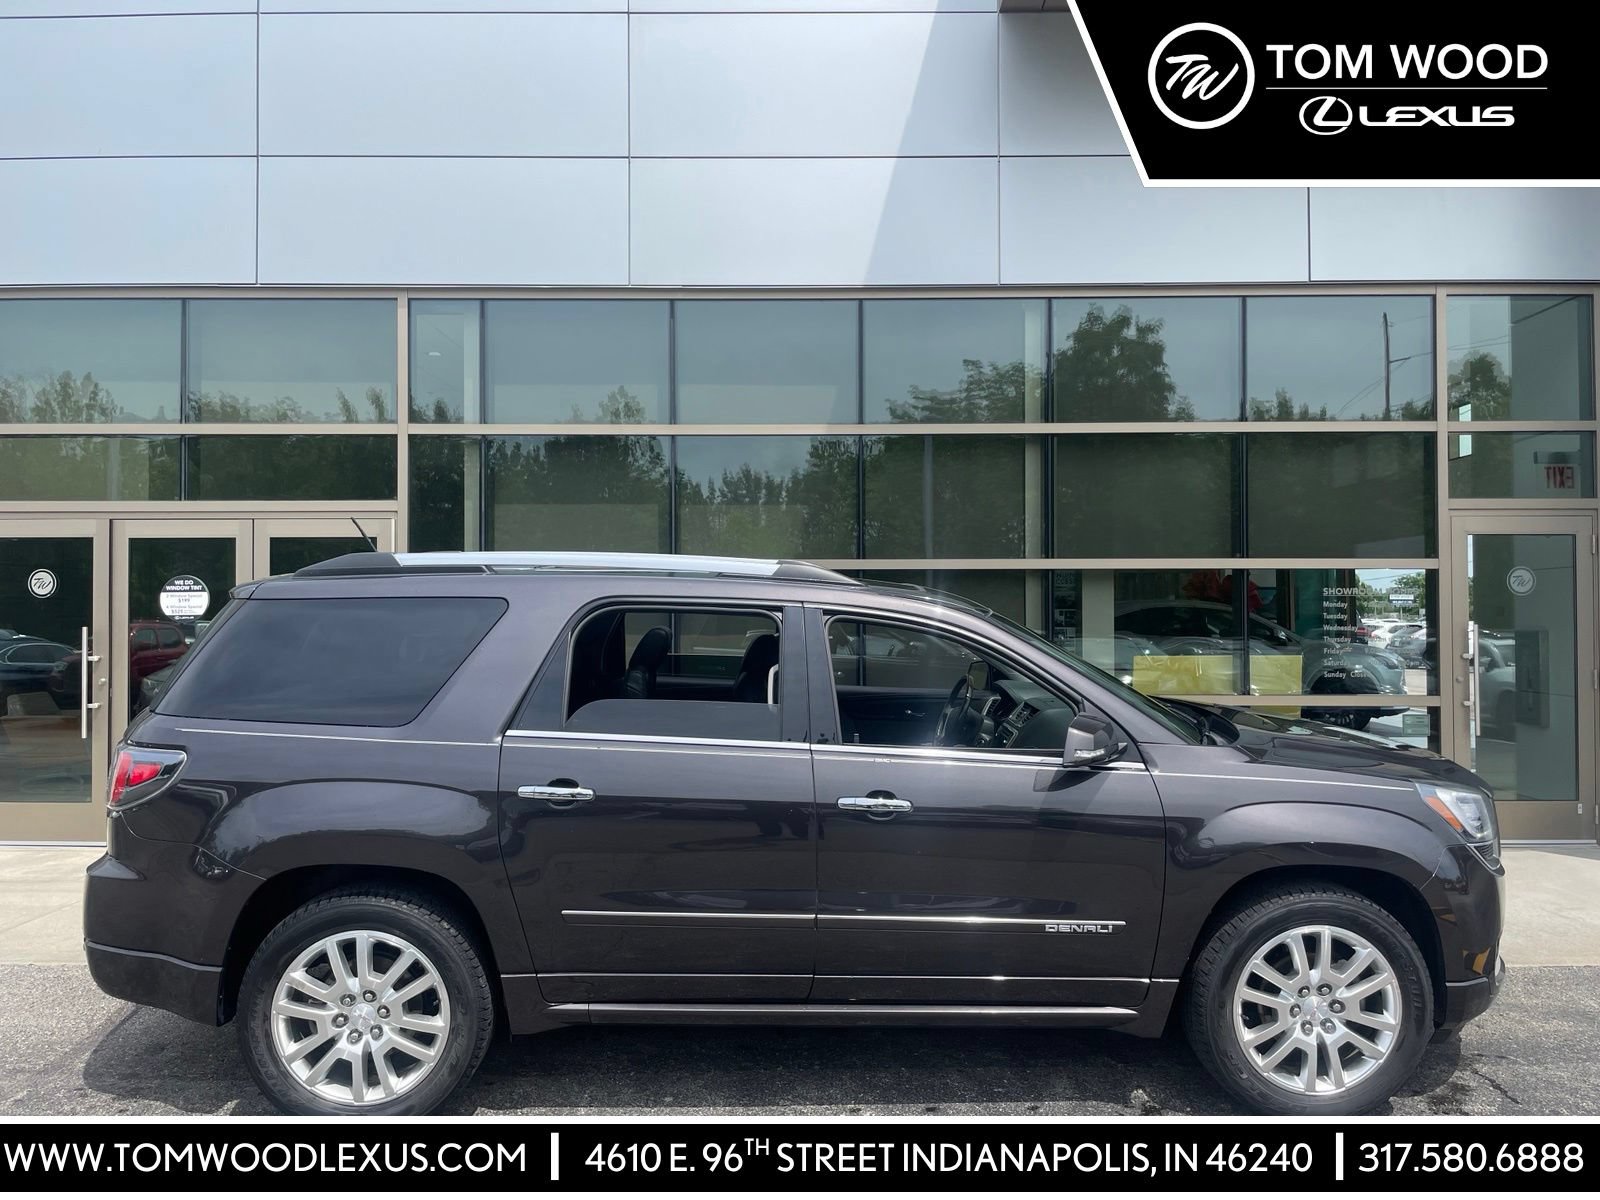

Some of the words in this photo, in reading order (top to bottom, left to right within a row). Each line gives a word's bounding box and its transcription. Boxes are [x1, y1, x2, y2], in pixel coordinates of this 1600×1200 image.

[1323, 601, 1347, 609] Monday
[1323, 612, 1347, 621] Tuesday
[1323, 624, 1358, 632] Wednesday
[1324, 636, 1351, 644] Thursday
[1324, 647, 1343, 656] Friday
[1324, 671, 1346, 679] Sunday
[1045, 924, 1113, 933] DENALI
